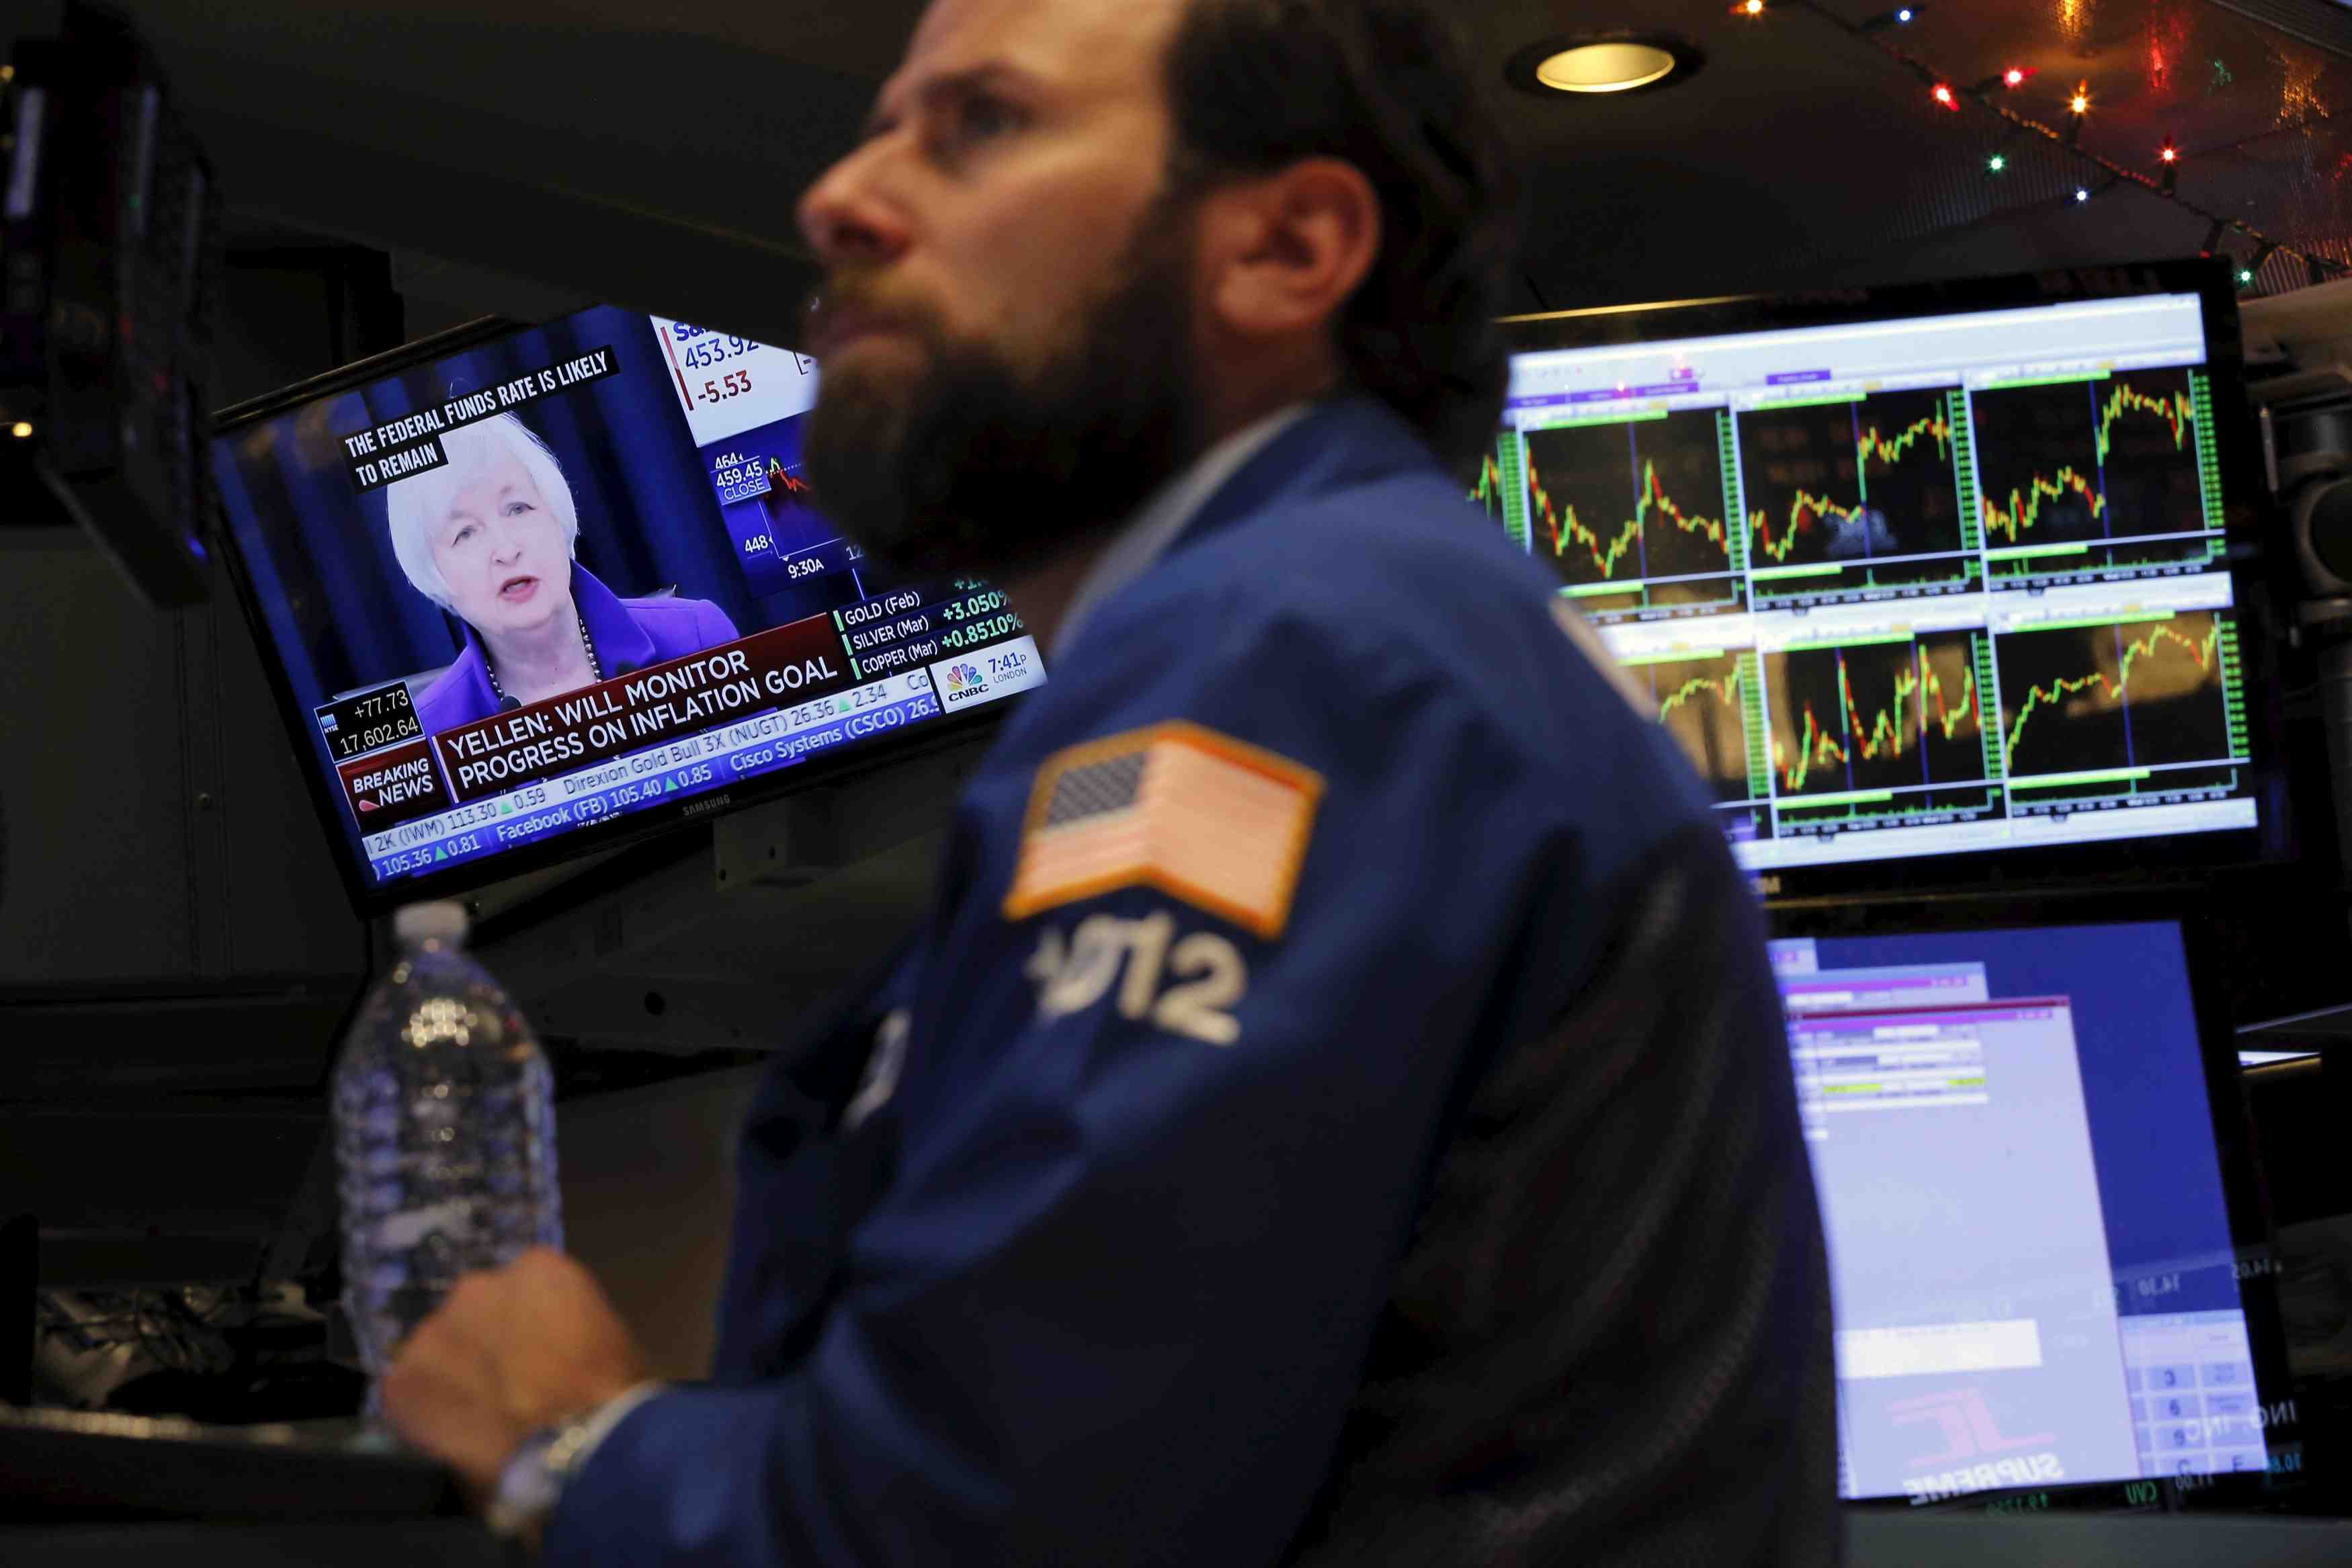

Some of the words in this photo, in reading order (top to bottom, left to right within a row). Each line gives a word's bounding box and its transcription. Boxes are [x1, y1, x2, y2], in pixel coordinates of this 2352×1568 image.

[698, 369, 752, 403] -5.53
[345, 431, 377, 458] THE
[376, 409, 445, 448] FEDERAL
[444, 390, 497, 425] FUNDS
[497, 376, 538, 406] RATE
[538, 369, 556, 392] IS
[556, 351, 608, 386] LIKELY
[355, 464, 378, 486] TO
[378, 442, 438, 480] REMAIN
[715, 451, 739, 470] 464
[716, 461, 764, 488] 459.45
[724, 478, 765, 500] CLOSE
[745, 535, 768, 554] 448
[788, 558, 825, 578] 9:30A
[845, 603, 882, 625] GOLD
[885, 591, 921, 615] (Feb)
[853, 625, 896, 650] SILVER
[897, 615, 930, 638] (Mar)
[941, 612, 1023, 648] +0.8510%
[862, 648, 908, 673] COPPER
[908, 640, 938, 662] (Mar)
[988, 652, 1027, 673] 7:41P
[993, 667, 1027, 684] LONDON
[354, 689, 409, 718] +77.73
[446, 711, 553, 760] YELLEN:
[554, 691, 623, 727] WILL
[624, 649, 751, 707] MONITOR
[948, 683, 990, 702] CNBC
[340, 715, 419, 754] 17,602.64
[458, 732, 585, 789] PROGRESS
[589, 718, 628, 749] ON
[629, 676, 761, 737] INFLATION
[765, 655, 838, 694] GOAL
[353, 757, 429, 794] BREAKING
[374, 833, 397, 853] 2K
[398, 818, 445, 846] (IWM)
[448, 802, 497, 830] 113.30
[513, 787, 546, 810] 0.59
[563, 765, 629, 795] Direxion
[631, 752, 669, 774] Gold
[670, 739, 701, 763] Bull
[703, 734, 726, 752] 3X
[729, 714, 789, 746] (NUGT)
[790, 700, 835, 727] 26.36
[851, 683, 887, 707] 2.34
[378, 775, 434, 807] NEWS
[382, 848, 432, 876] 105.36
[447, 834, 482, 857] 0.81
[495, 808, 573, 842] Facebook
[573, 795, 608, 820] (FB)
[610, 779, 662, 808] 105.40
[677, 763, 712, 788] 0.85
[730, 748, 773, 772] Cisco
[774, 726, 843, 759] Systems
[843, 707, 906, 740] (CSCO)
[682, 794, 730, 816] SAMSUNG
